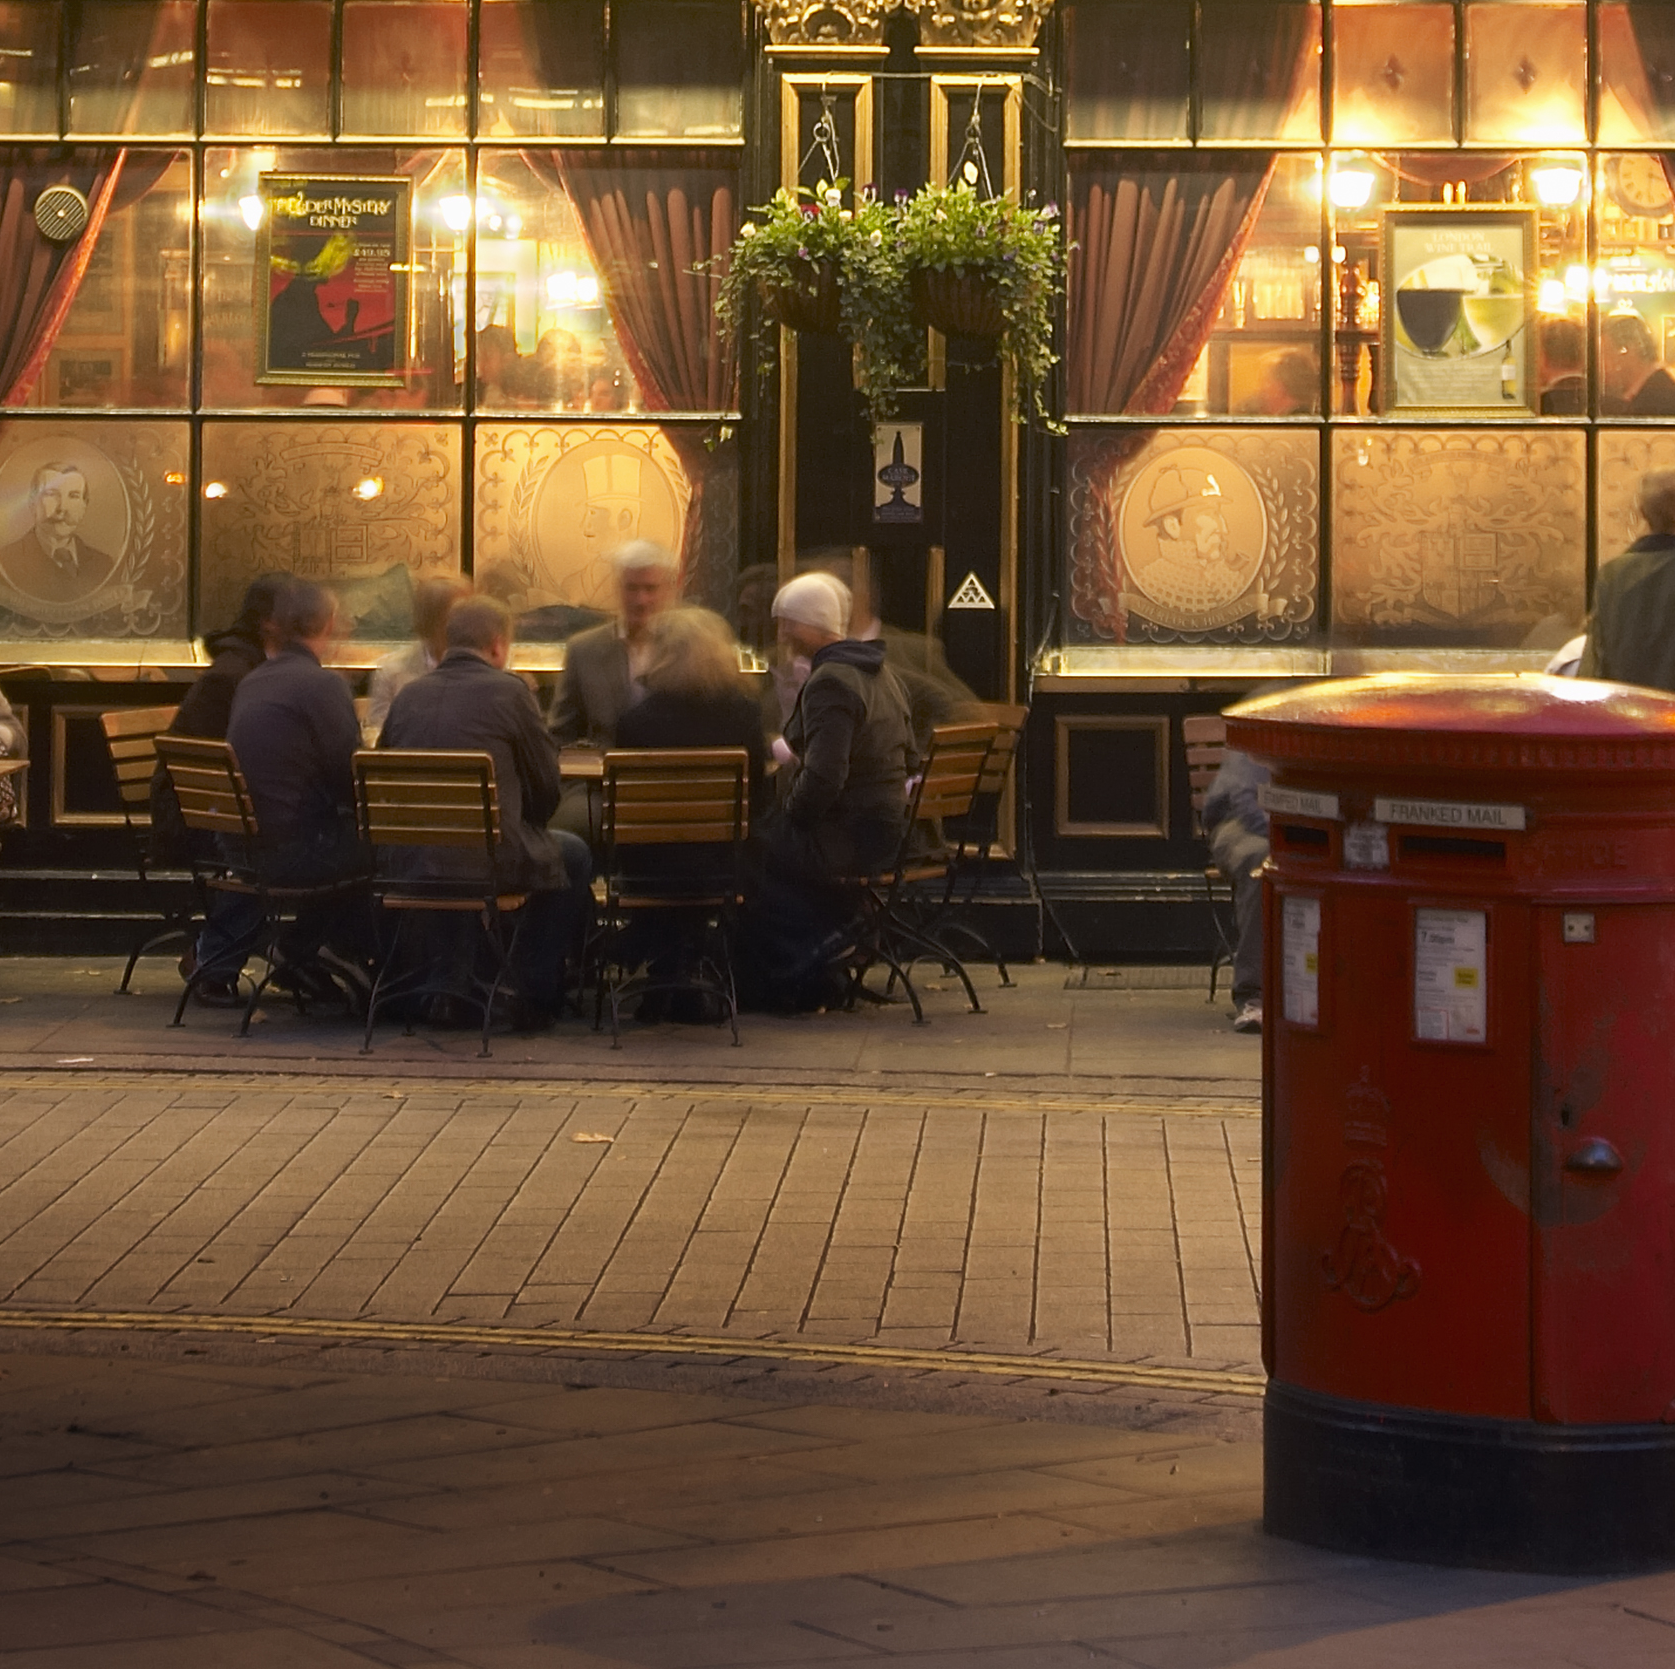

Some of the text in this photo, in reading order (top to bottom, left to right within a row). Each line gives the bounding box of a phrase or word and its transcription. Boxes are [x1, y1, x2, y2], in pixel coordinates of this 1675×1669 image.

[1136, 599, 1253, 629] SHERLOCK HOLMES
[1389, 803, 1508, 826] FRANKED MAIL
